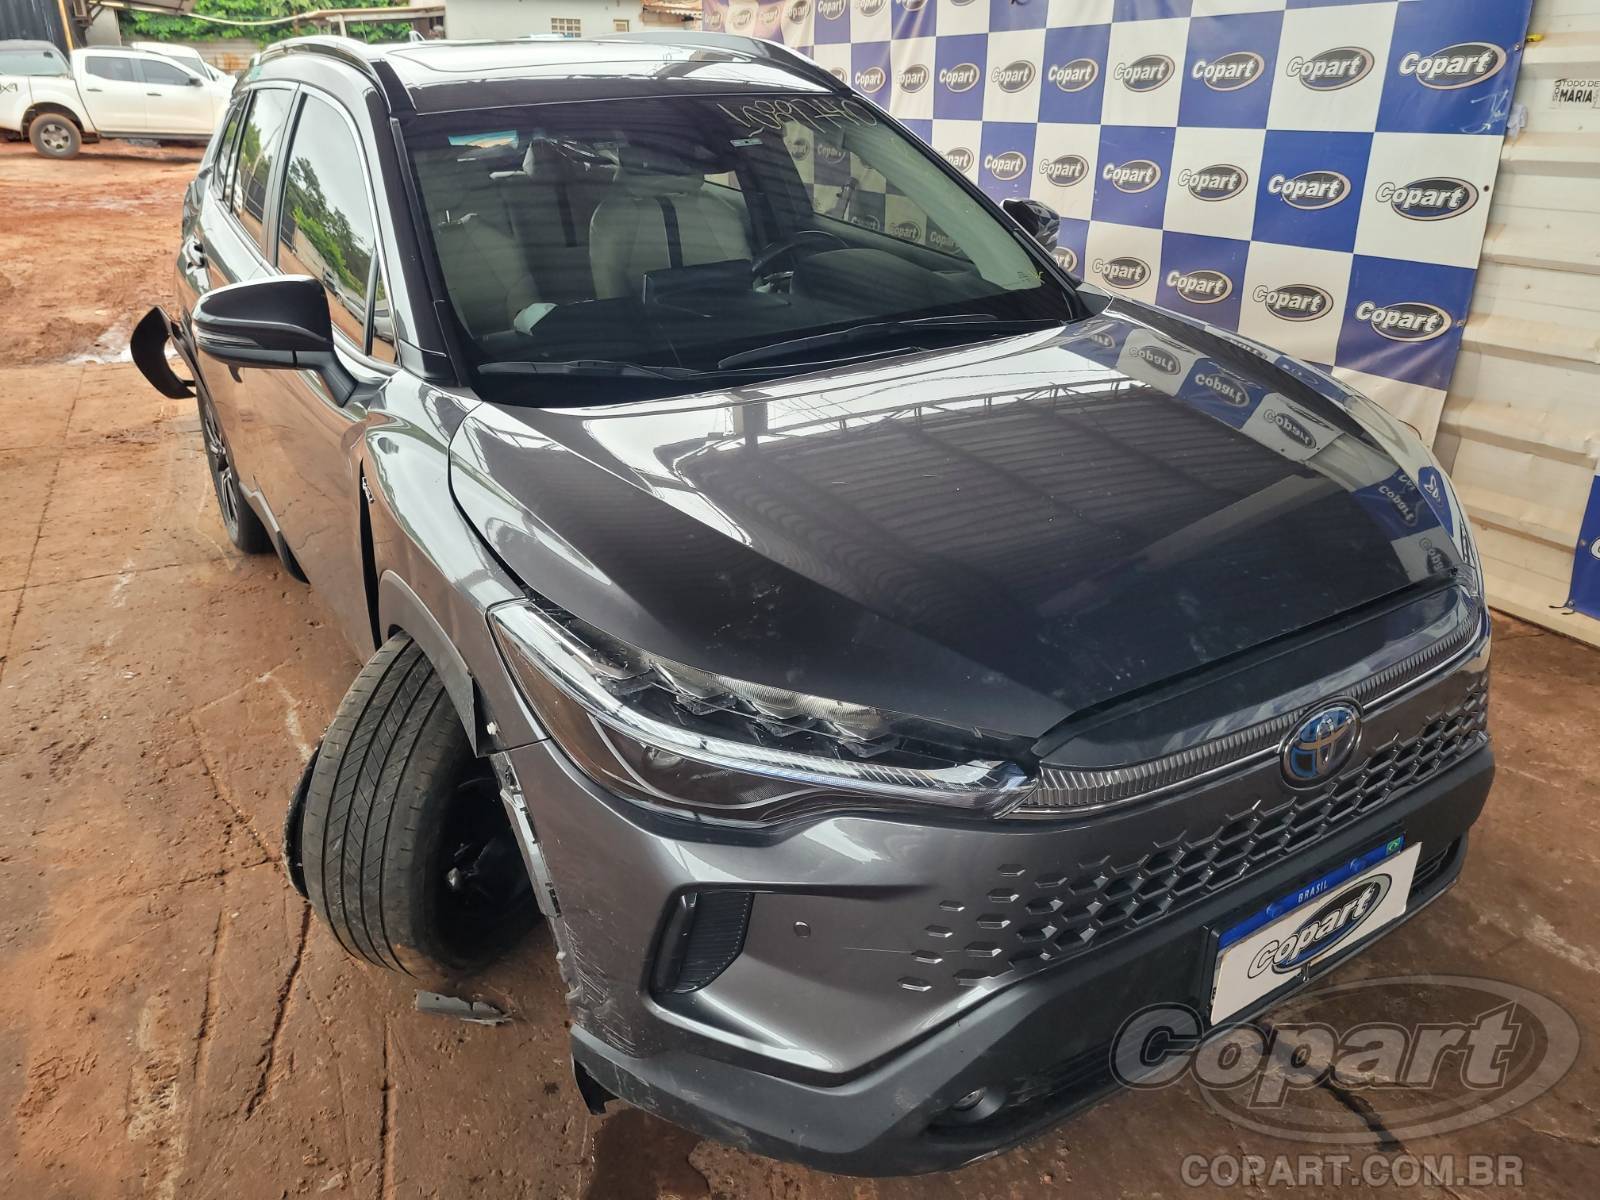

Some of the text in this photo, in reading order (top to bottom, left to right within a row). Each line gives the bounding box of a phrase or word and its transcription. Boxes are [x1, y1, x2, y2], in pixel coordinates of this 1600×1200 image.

[939, 68, 974, 87] Copart
[991, 65, 1029, 85] Copart
[1048, 64, 1092, 85] Copart
[1114, 61, 1166, 83] Copart
[1192, 58, 1255, 81] Copart
[1287, 54, 1361, 80] Copart
[1399, 50, 1491, 82] Copart
[855, 71, 881, 87] Copart
[1559, 89, 1592, 103] MARIA
[984, 154, 1021, 173] Copart
[1039, 158, 1082, 178] Copart
[1103, 164, 1154, 185] Copart
[1178, 168, 1241, 191] Copart
[1268, 174, 1343, 199] Copart
[1376, 182, 1465, 209] Copart
[1092, 258, 1145, 281] Copart
[1167, 271, 1225, 296] Copart
[1253, 284, 1323, 312] Copart
[1355, 301, 1442, 334] Copart
[1298, 880, 1328, 903] BRASIL
[1247, 880, 1376, 979] Copart
